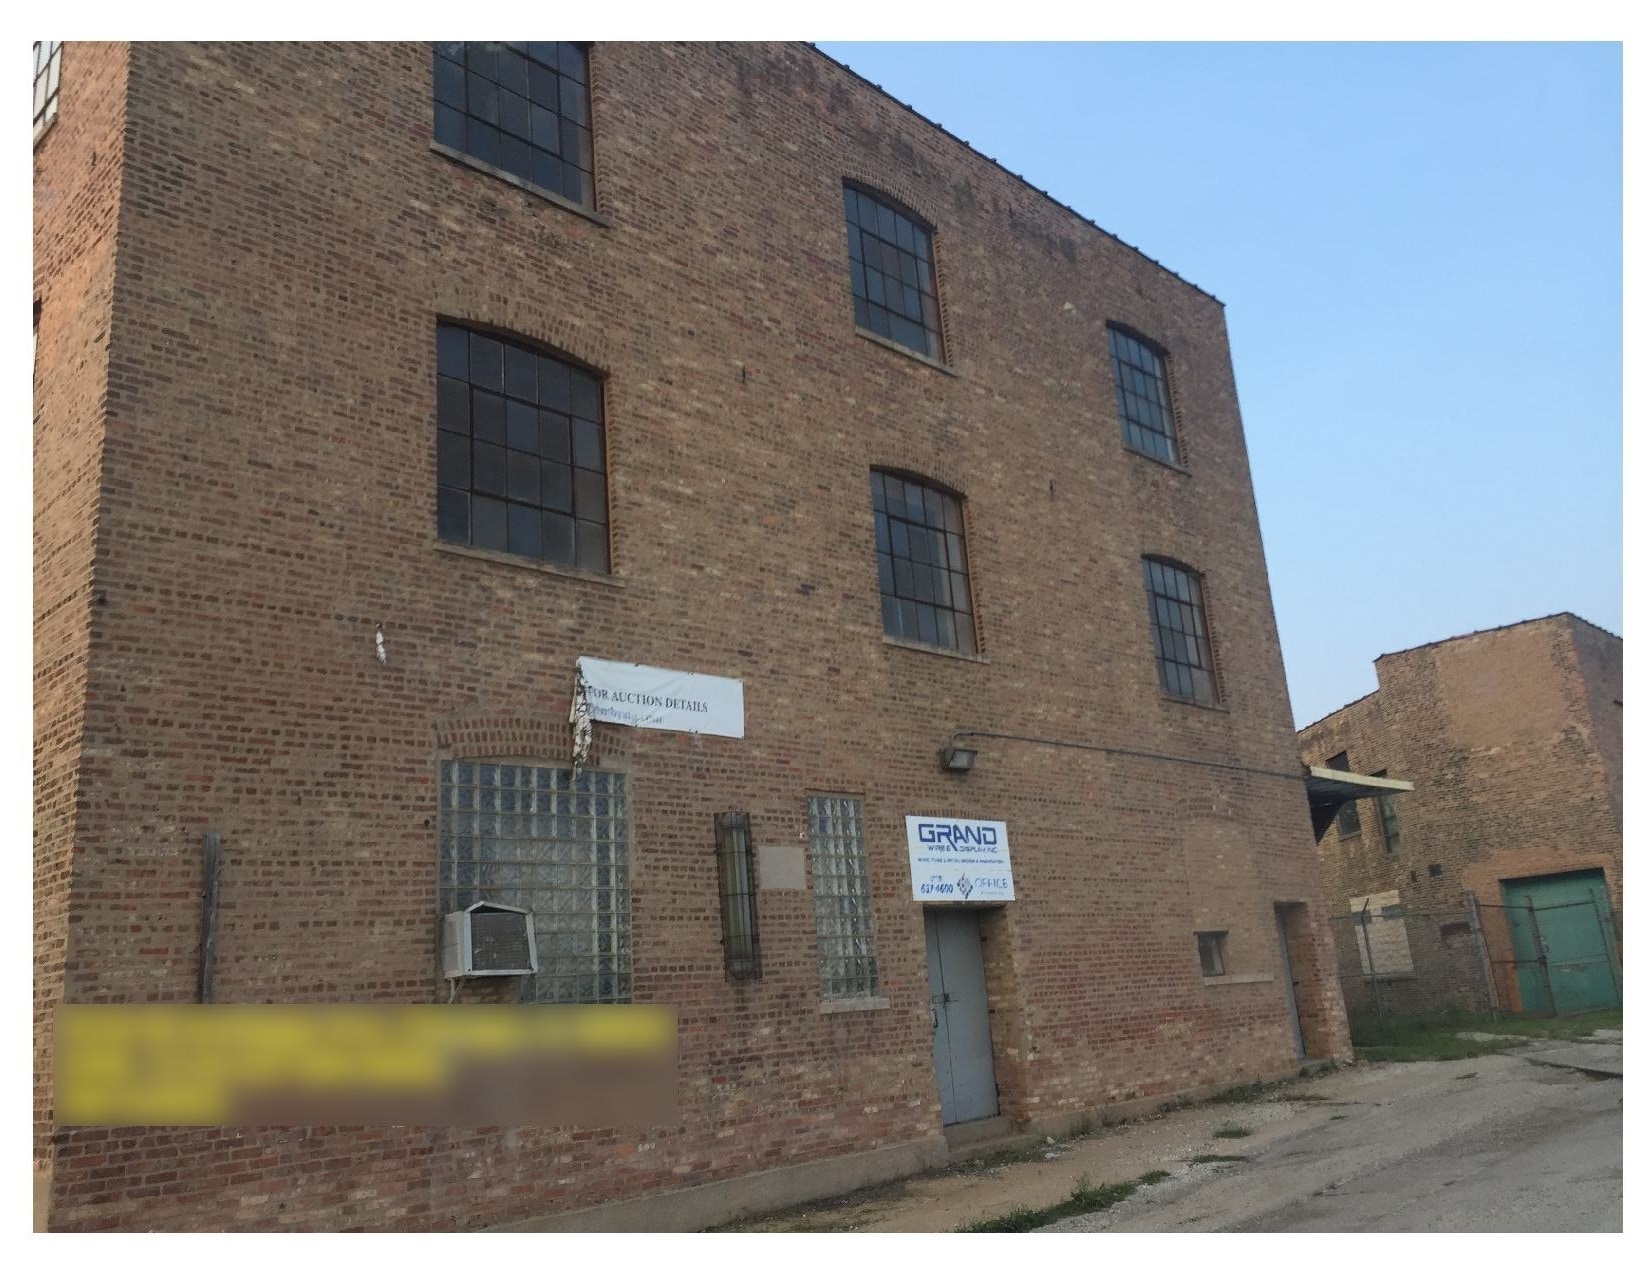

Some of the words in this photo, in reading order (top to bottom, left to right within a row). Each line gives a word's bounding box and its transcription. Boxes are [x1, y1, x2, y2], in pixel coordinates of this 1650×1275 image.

[611, 690, 664, 708] AUCTION
[665, 697, 708, 713] DETAILS
[918, 823, 997, 851] GRAND
[975, 878, 1008, 889] OFFICE
